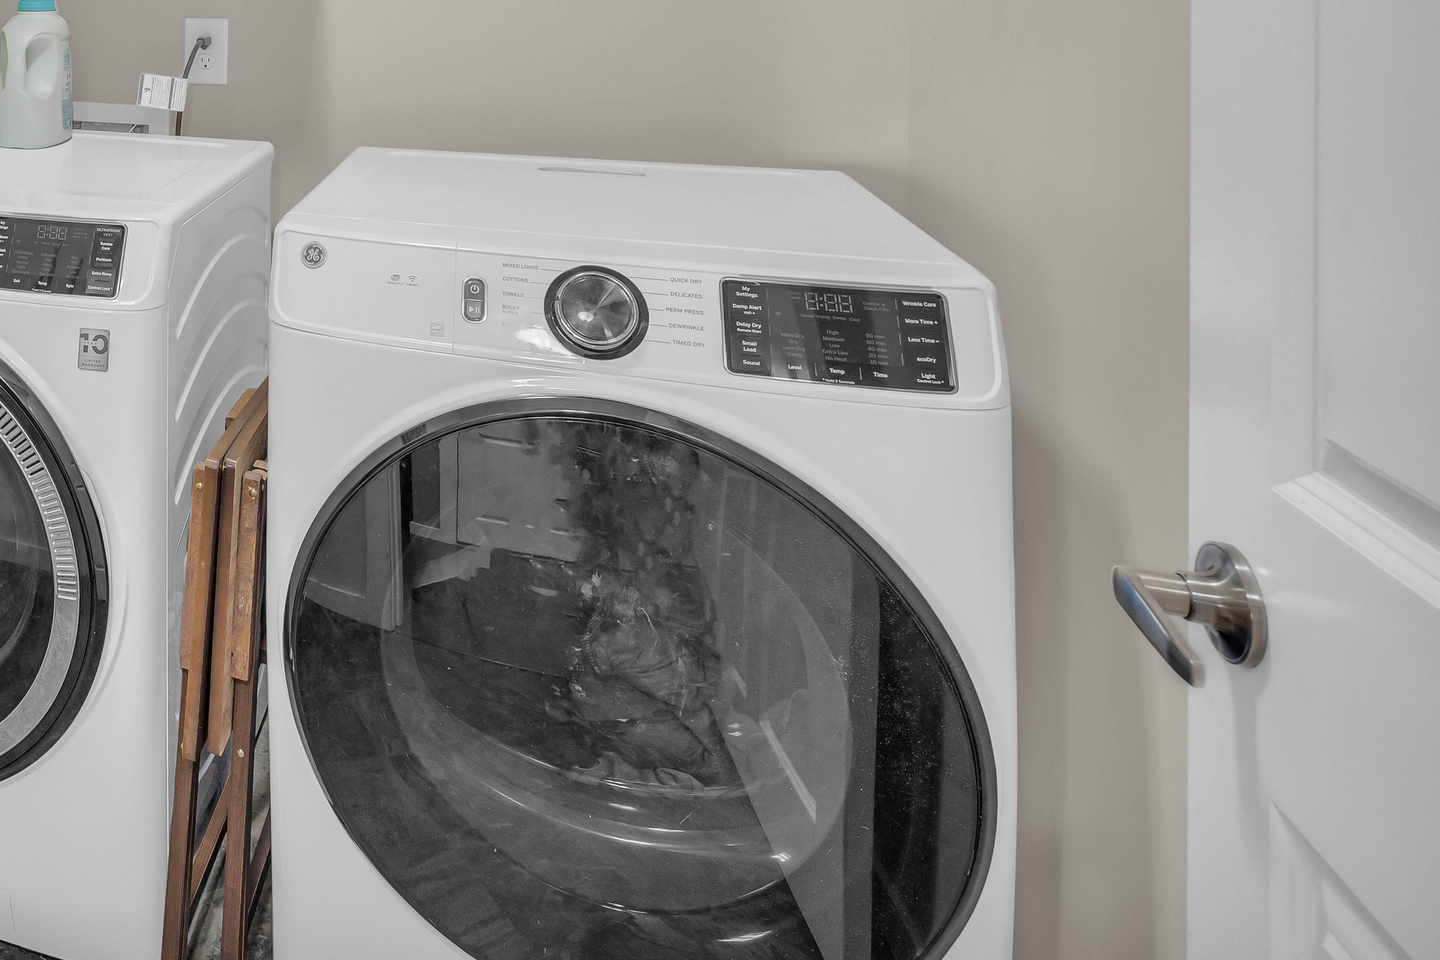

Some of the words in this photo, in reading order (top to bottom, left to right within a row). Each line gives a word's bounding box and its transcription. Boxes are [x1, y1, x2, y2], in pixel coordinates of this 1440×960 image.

[670, 291, 703, 299] DELICATES
[735, 291, 758, 299] Settings
[684, 308, 704, 316] PRESS
[668, 323, 705, 331] DEWRINKLE
[80, 333, 109, 355] 10
[742, 359, 760, 367] Sound
[916, 356, 937, 364] ecoDry
[829, 368, 845, 376] Temp
[921, 372, 936, 380] Light
